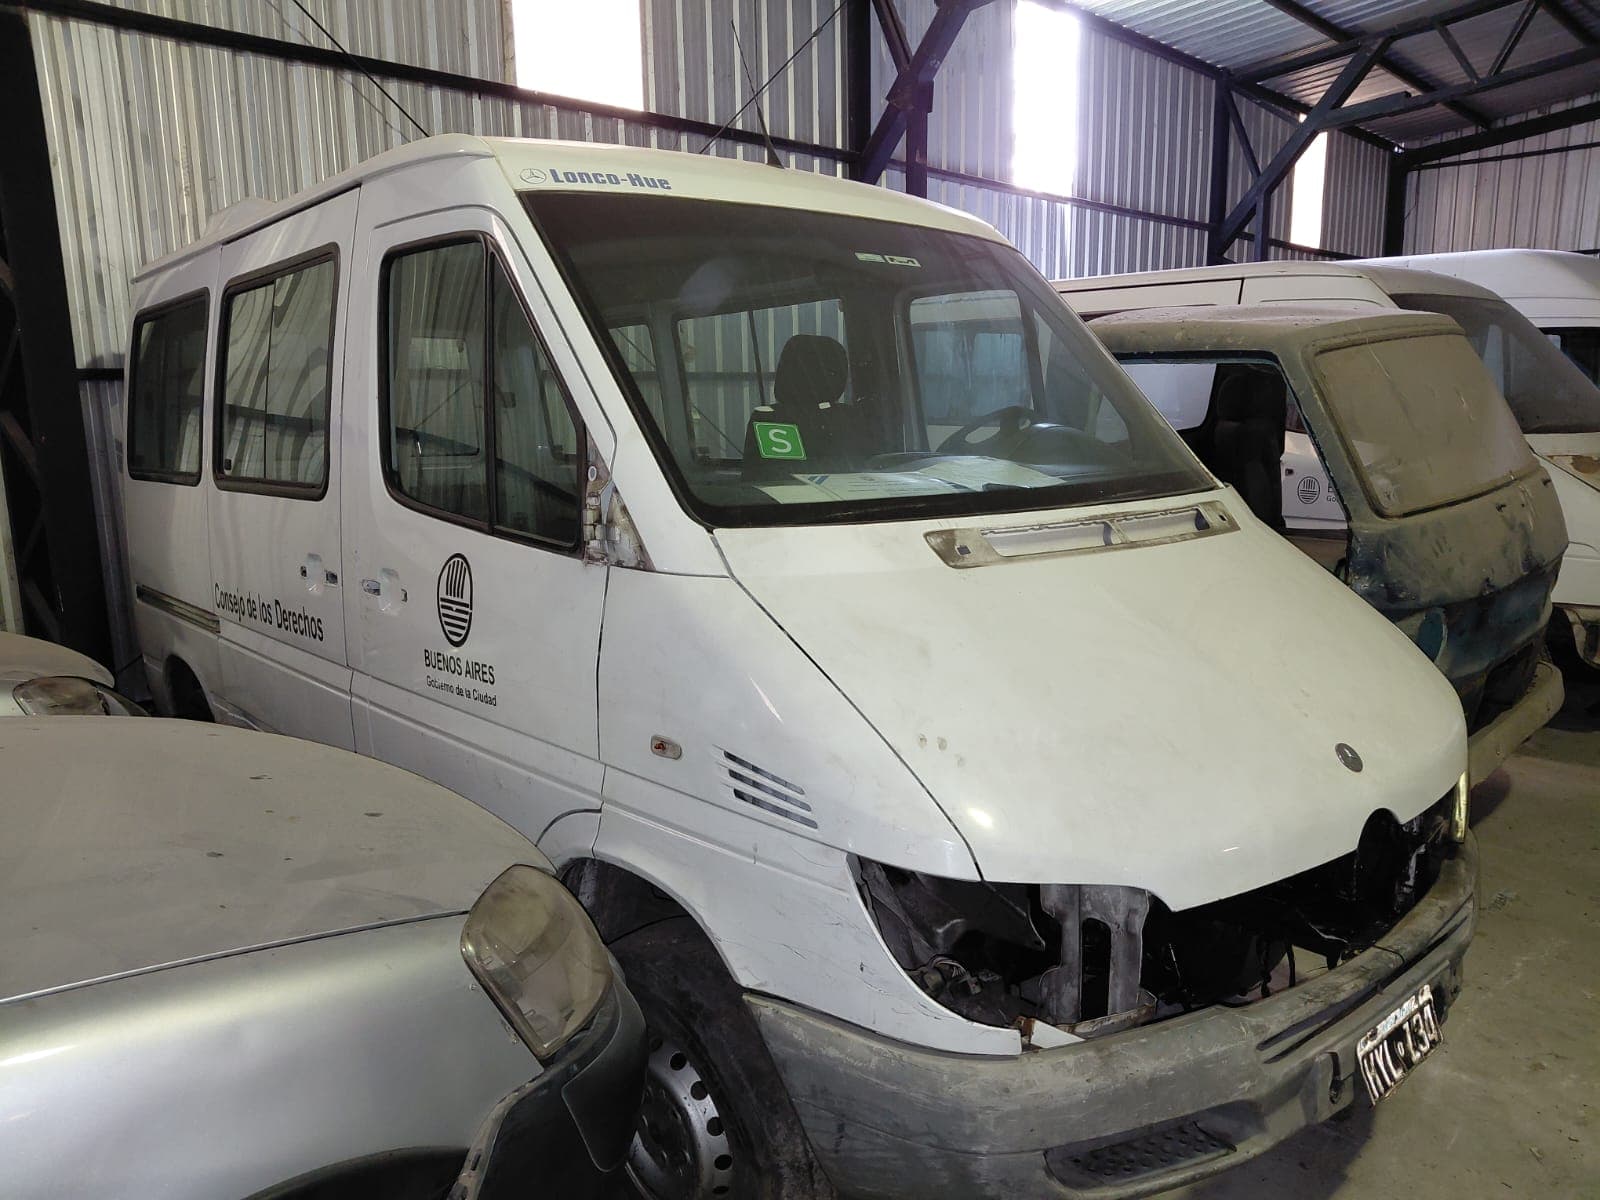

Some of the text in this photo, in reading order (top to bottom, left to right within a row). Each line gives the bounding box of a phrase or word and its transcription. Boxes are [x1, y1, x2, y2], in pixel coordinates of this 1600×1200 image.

[549, 168, 672, 190] Lonco-Hue
[768, 428, 792, 453] S
[214, 582, 324, 642] Consejo de los Derechos
[424, 648, 495, 685] BUENOS AIRES
[455, 684, 465, 697] de
[465, 688, 471, 699] la
[472, 688, 497, 707] Ciudad
